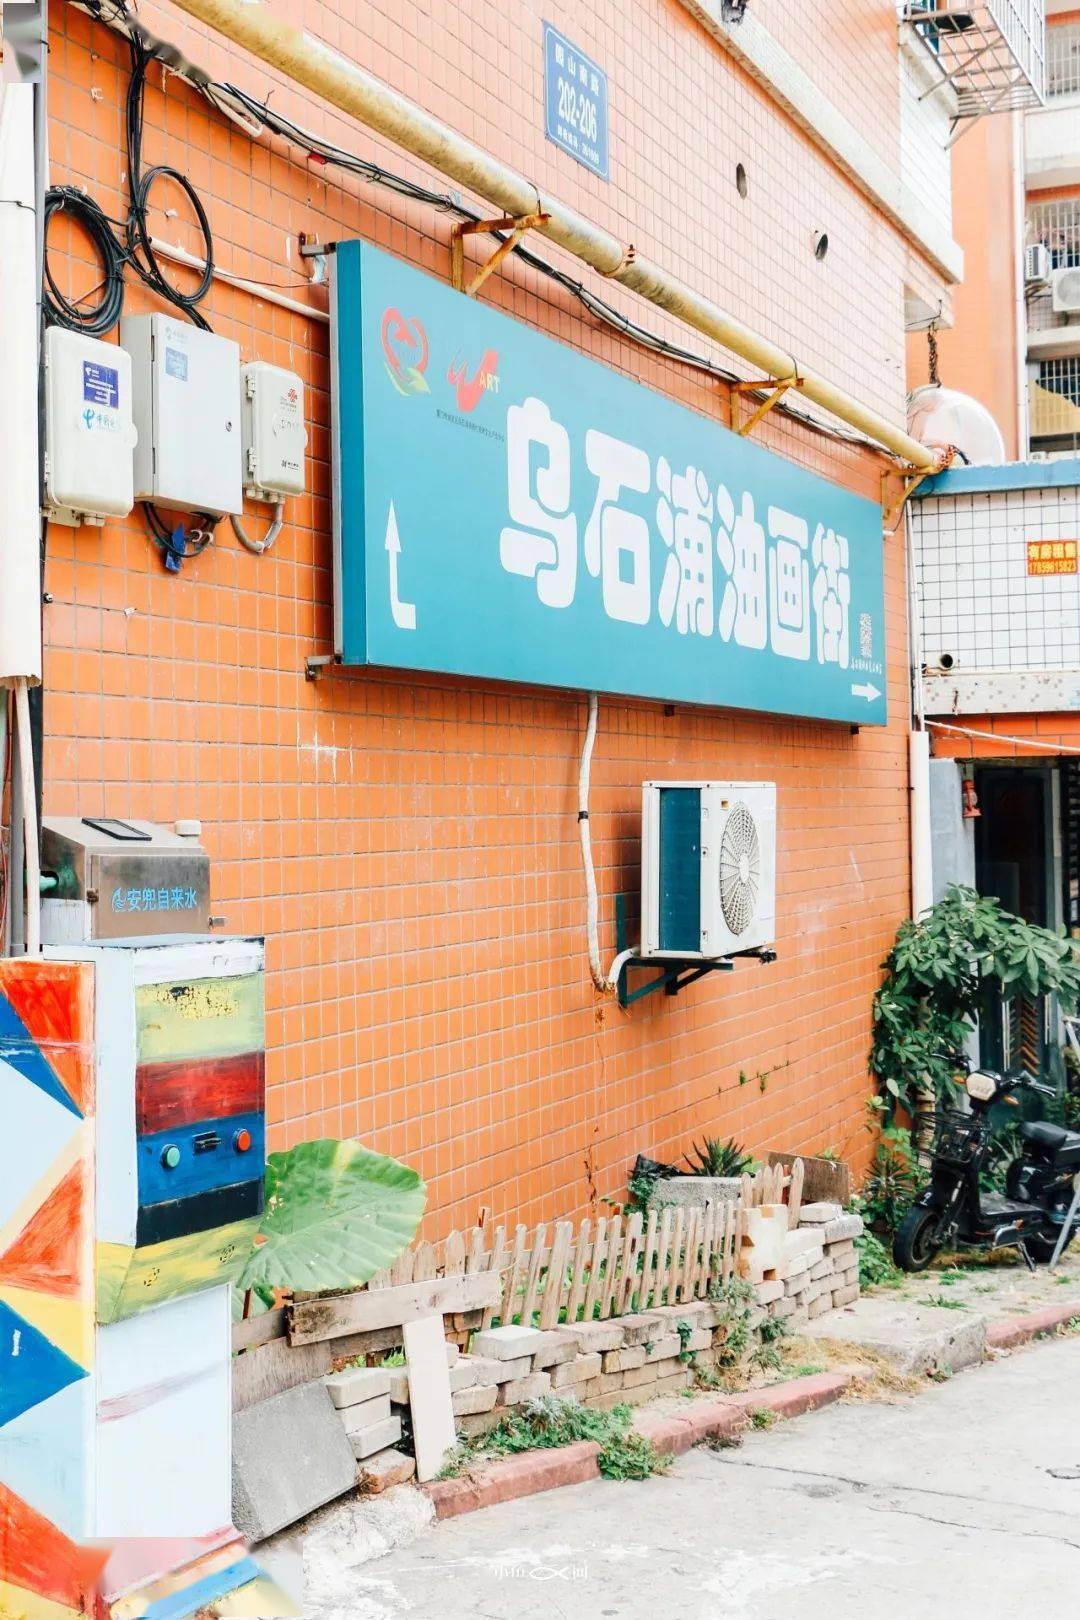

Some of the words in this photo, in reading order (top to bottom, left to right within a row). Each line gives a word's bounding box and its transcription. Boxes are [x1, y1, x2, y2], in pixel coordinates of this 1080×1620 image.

[558, 77, 597, 143] 202-206
[479, 372, 501, 393] ART
[500, 396, 850, 669] 乌石浦油画街
[126, 886, 198, 912] 安兜自来水
